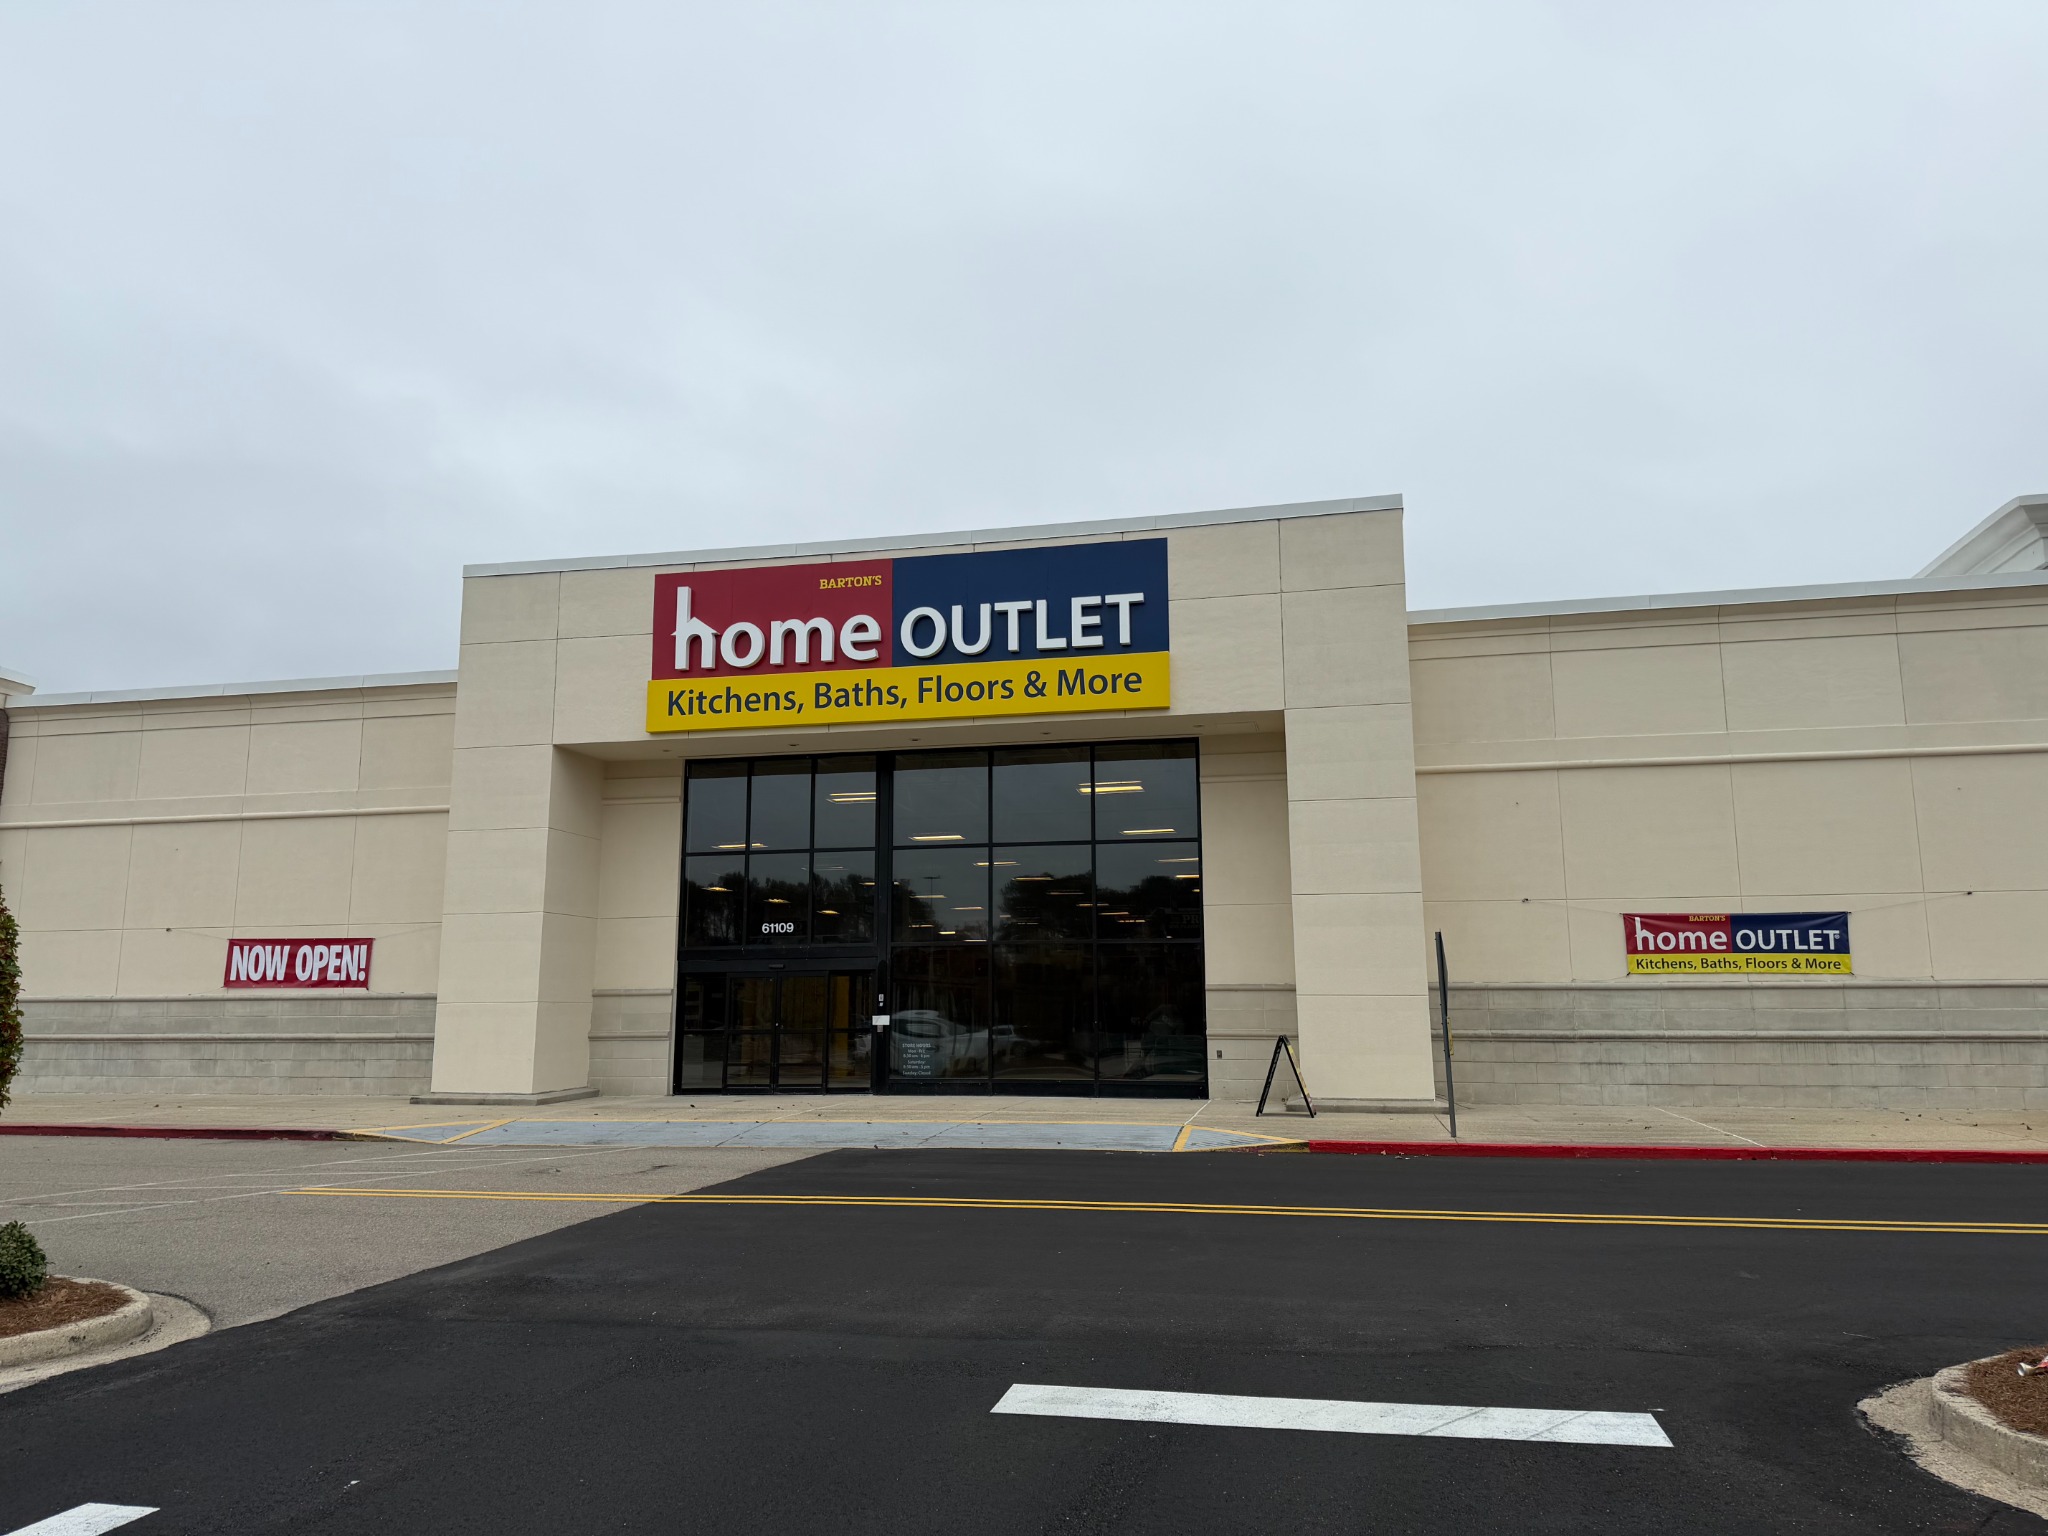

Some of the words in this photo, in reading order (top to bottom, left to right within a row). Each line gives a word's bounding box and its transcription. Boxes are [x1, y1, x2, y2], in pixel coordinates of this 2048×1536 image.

[819, 575, 882, 590] BARTON'S
[670, 586, 882, 671] home
[900, 592, 1145, 658] OUTLET
[667, 686, 804, 717] Kitchens,
[814, 679, 908, 709] Baths,
[918, 674, 1015, 704] Floors
[1024, 671, 1048, 698] &
[1057, 668, 1143, 697] More
[761, 922, 794, 934] 61109
[1688, 914, 1726, 922] BARTON'S
[1635, 916, 1728, 951] home
[229, 944, 291, 982] NOW
[295, 944, 368, 982] OPEN!
[1635, 957, 1697, 971] Kitchens,
[1700, 957, 1742, 971] Baths,
[1745, 956, 1788, 969] Floors
[1791, 957, 1802, 969] &
[1805, 957, 1842, 970] More
